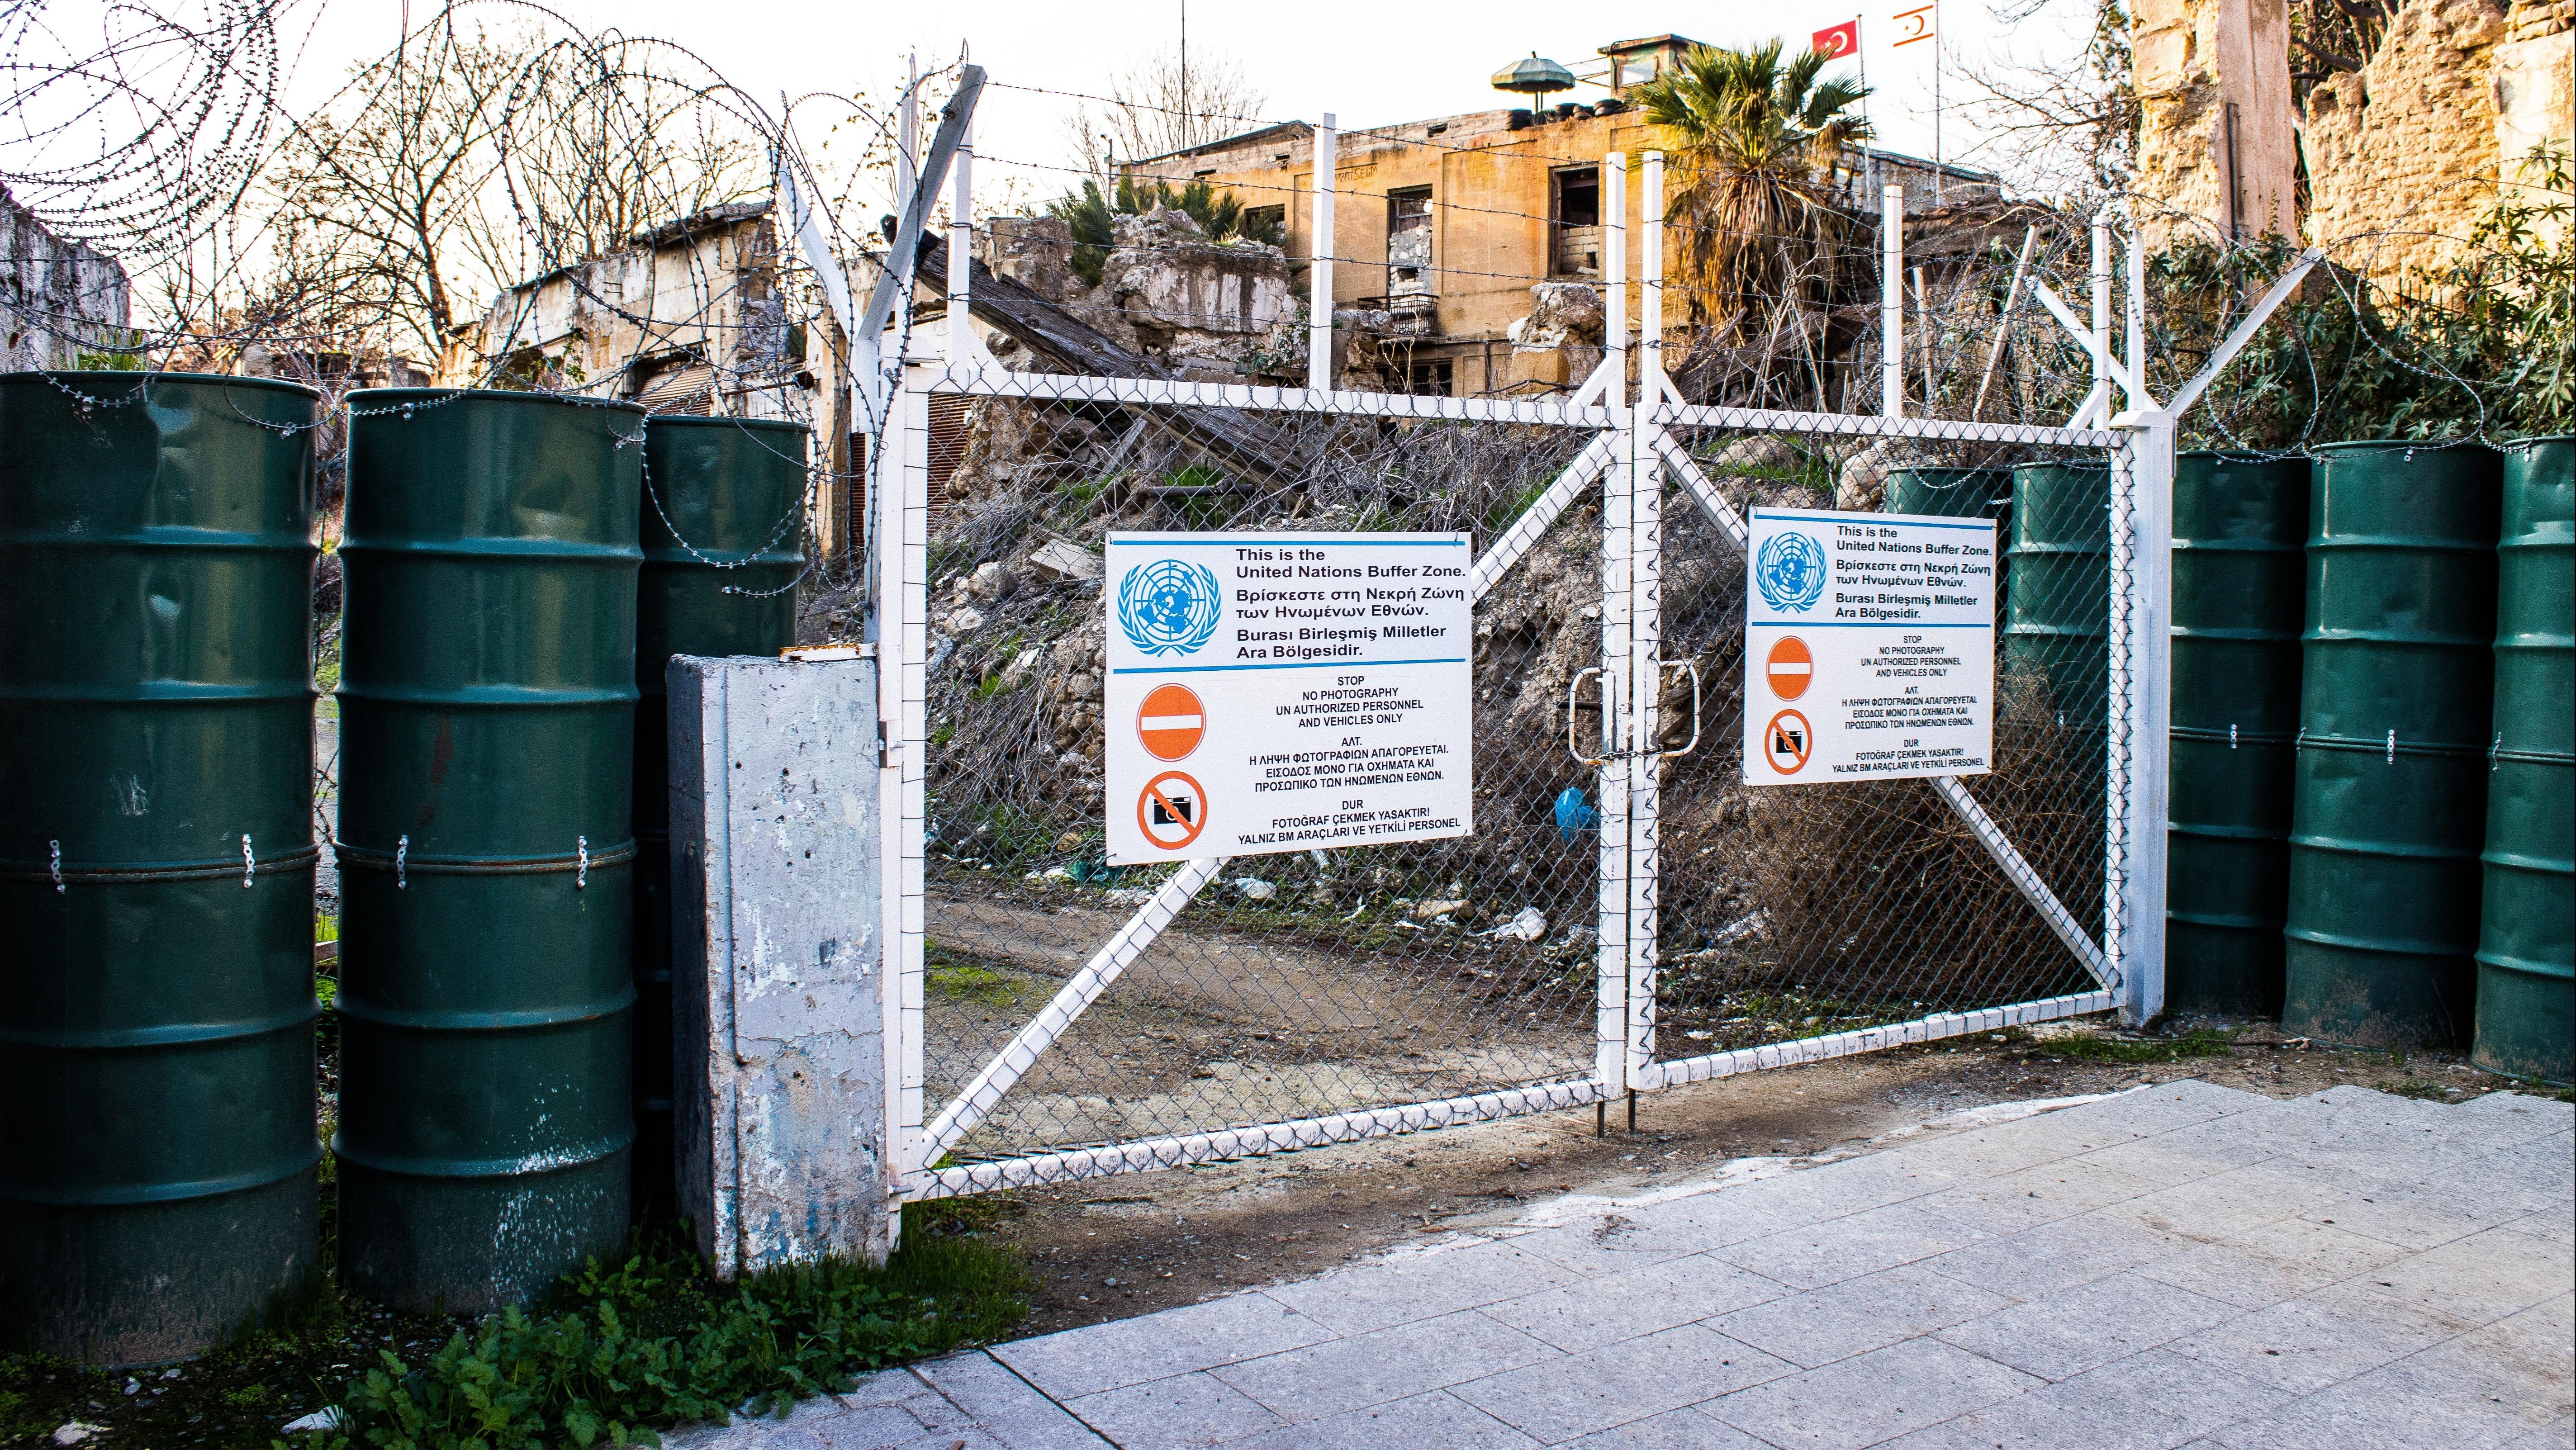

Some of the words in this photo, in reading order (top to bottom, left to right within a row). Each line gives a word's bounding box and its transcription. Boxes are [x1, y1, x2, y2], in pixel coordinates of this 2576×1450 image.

[1836, 525, 1862, 536] This
[1866, 526, 1876, 537] is
[1879, 527, 1897, 538] the
[1235, 549, 1273, 561] This
[1279, 549, 1293, 561] is
[1299, 549, 1325, 560] the
[1836, 540, 1875, 551] United
[1879, 541, 1922, 553] Nations
[1925, 544, 1960, 554] Buffer
[1961, 545, 1992, 556] Zone.
[1237, 566, 1292, 578] United
[1299, 566, 1362, 578] Nations
[1368, 565, 1418, 577] Buffer
[1422, 565, 1466, 577] Zone.
[1836, 559, 1897, 572] Βρίσκεστε
[1900, 564, 1920, 574] στη
[1924, 562, 1958, 575] Νεκρή
[1960, 564, 1990, 577] Ζώνη
[1835, 576, 1858, 584] των
[1862, 574, 1923, 588] Ηνωμένων
[1927, 576, 1966, 587] Εθνών.
[1237, 589, 1325, 604] Βρίσκεστε
[1331, 591, 1360, 602] στη
[1366, 587, 1416, 602] Νεκρή
[1421, 587, 1464, 601] Ζώνη
[1836, 592, 1874, 603] Burası
[1878, 593, 1931, 607] Birleşmiş
[1934, 595, 1978, 605] Milletler
[1236, 609, 1269, 619] των
[1275, 605, 1366, 620] Ηνωμένων
[1371, 604, 1428, 616] Εθνών.
[1835, 607, 1856, 617] Ara
[1860, 607, 1921, 621] Bölgesidir.
[1237, 629, 1292, 641] Burası
[1299, 627, 1377, 642] Birleşmiş
[1383, 625, 1447, 638] Milletler
[1903, 635, 1922, 644] STOP
[1236, 647, 1267, 659] Ara
[1273, 644, 1362, 660] Bölgesidir.
[1879, 646, 1890, 655] NO
[1892, 646, 1945, 654] PHOTOGRAPHY
[1861, 658, 1872, 666] UN
[1873, 658, 1918, 666] AUTHORIZED
[1920, 657, 1962, 665] PERSONNEL
[1875, 669, 1892, 677] AND
[1893, 668, 1927, 677] VEHICLES
[1929, 668, 1947, 676] ONLY
[1338, 676, 1364, 686] STOP
[1303, 691, 1318, 701] NO
[1321, 687, 1399, 700] PHOTOGRAPHY
[1904, 686, 1918, 694] ΑΛΤ.
[1276, 706, 1290, 716] UN
[1293, 702, 1360, 715] AUTHORIZED
[1363, 699, 1424, 711] PERSONNEL
[1848, 698, 1870, 707] ΛΗΨΗ
[1871, 697, 1923, 706] ΦΩΤΟΓΡΑΦΙΩΝ
[1924, 696, 1978, 705] ΑΠΑΓΟΡΕΥΕΤΑΙ.
[1853, 709, 1884, 718] ΕΙΣΟΔΟΣ
[1885, 708, 1907, 717] ΜΟΝΟ
[1909, 708, 1920, 716] ΓΙΑ
[1921, 707, 1954, 716] ΟΧΗΜΑΤΑ
[1956, 706, 1968, 715] ΚΑΙ
[1298, 717, 1320, 728] AND
[1323, 715, 1373, 726] VEHICLES
[1376, 713, 1403, 724] ONLY
[1845, 720, 1888, 730] ΠΡΟΣΩΠΙΚΟ
[1889, 720, 1904, 728] ΤΩΝ
[1906, 718, 1947, 727] ΗΝΩΜΕΝΩΝ
[1948, 717, 1974, 726] ΕΘΝΩΝ.
[1341, 736, 1362, 747] ΑΛΤ.
[1903, 739, 1919, 747] DUR
[1259, 754, 1290, 765] ΛΗΨΗ
[1293, 749, 1368, 763] ΦΩΤΟΓΡΑΦΙΩΝ
[1371, 744, 1448, 758] ΑΠΑΓΟΡΕΥΕΤΑΙ.
[1855, 750, 1896, 761] FOTOĞRAF
[1897, 749, 1927, 760] ÇEKMEK
[1928, 748, 1963, 757] YASAKTIR!
[1266, 766, 1311, 778] ΕΙΣΟΔΟΣ
[1314, 764, 1345, 775] ΜΟΝΟ
[1348, 763, 1365, 772] ΓΙΑ
[1367, 759, 1415, 772] ΟΧΗΜΑΤΑ
[1418, 758, 1434, 768] ΚΑΙ
[1832, 764, 1859, 773] YALNIZ
[1860, 763, 1871, 772] BM
[1872, 762, 1909, 772] ARAÇLARI
[1910, 761, 1920, 769] VE
[1921, 758, 1947, 768] YETKİLİ
[1948, 758, 1985, 767] PERSONEL
[1255, 779, 1317, 792] ΠΡΟΣΩΠΙΚΟ
[1320, 777, 1341, 788] ΤΩΝ
[1344, 773, 1403, 786] ΗΝΩΜΕΝΩΝ
[1406, 770, 1444, 782] ΕΘΝΩΝ.
[1342, 800, 1364, 810] DUR
[1272, 815, 1329, 829] FOTOĞRAF
[1333, 811, 1376, 825] ÇEKMEK
[1378, 807, 1429, 820] YASAKTIR!
[1238, 833, 1276, 845] YALNIZ
[1278, 831, 1294, 842] BM
[1296, 827, 1349, 841] ARAÇLARI
[1352, 825, 1366, 835] VE
[1368, 820, 1405, 834] YETKİLİ
[1409, 818, 1461, 831] PERSONEL
